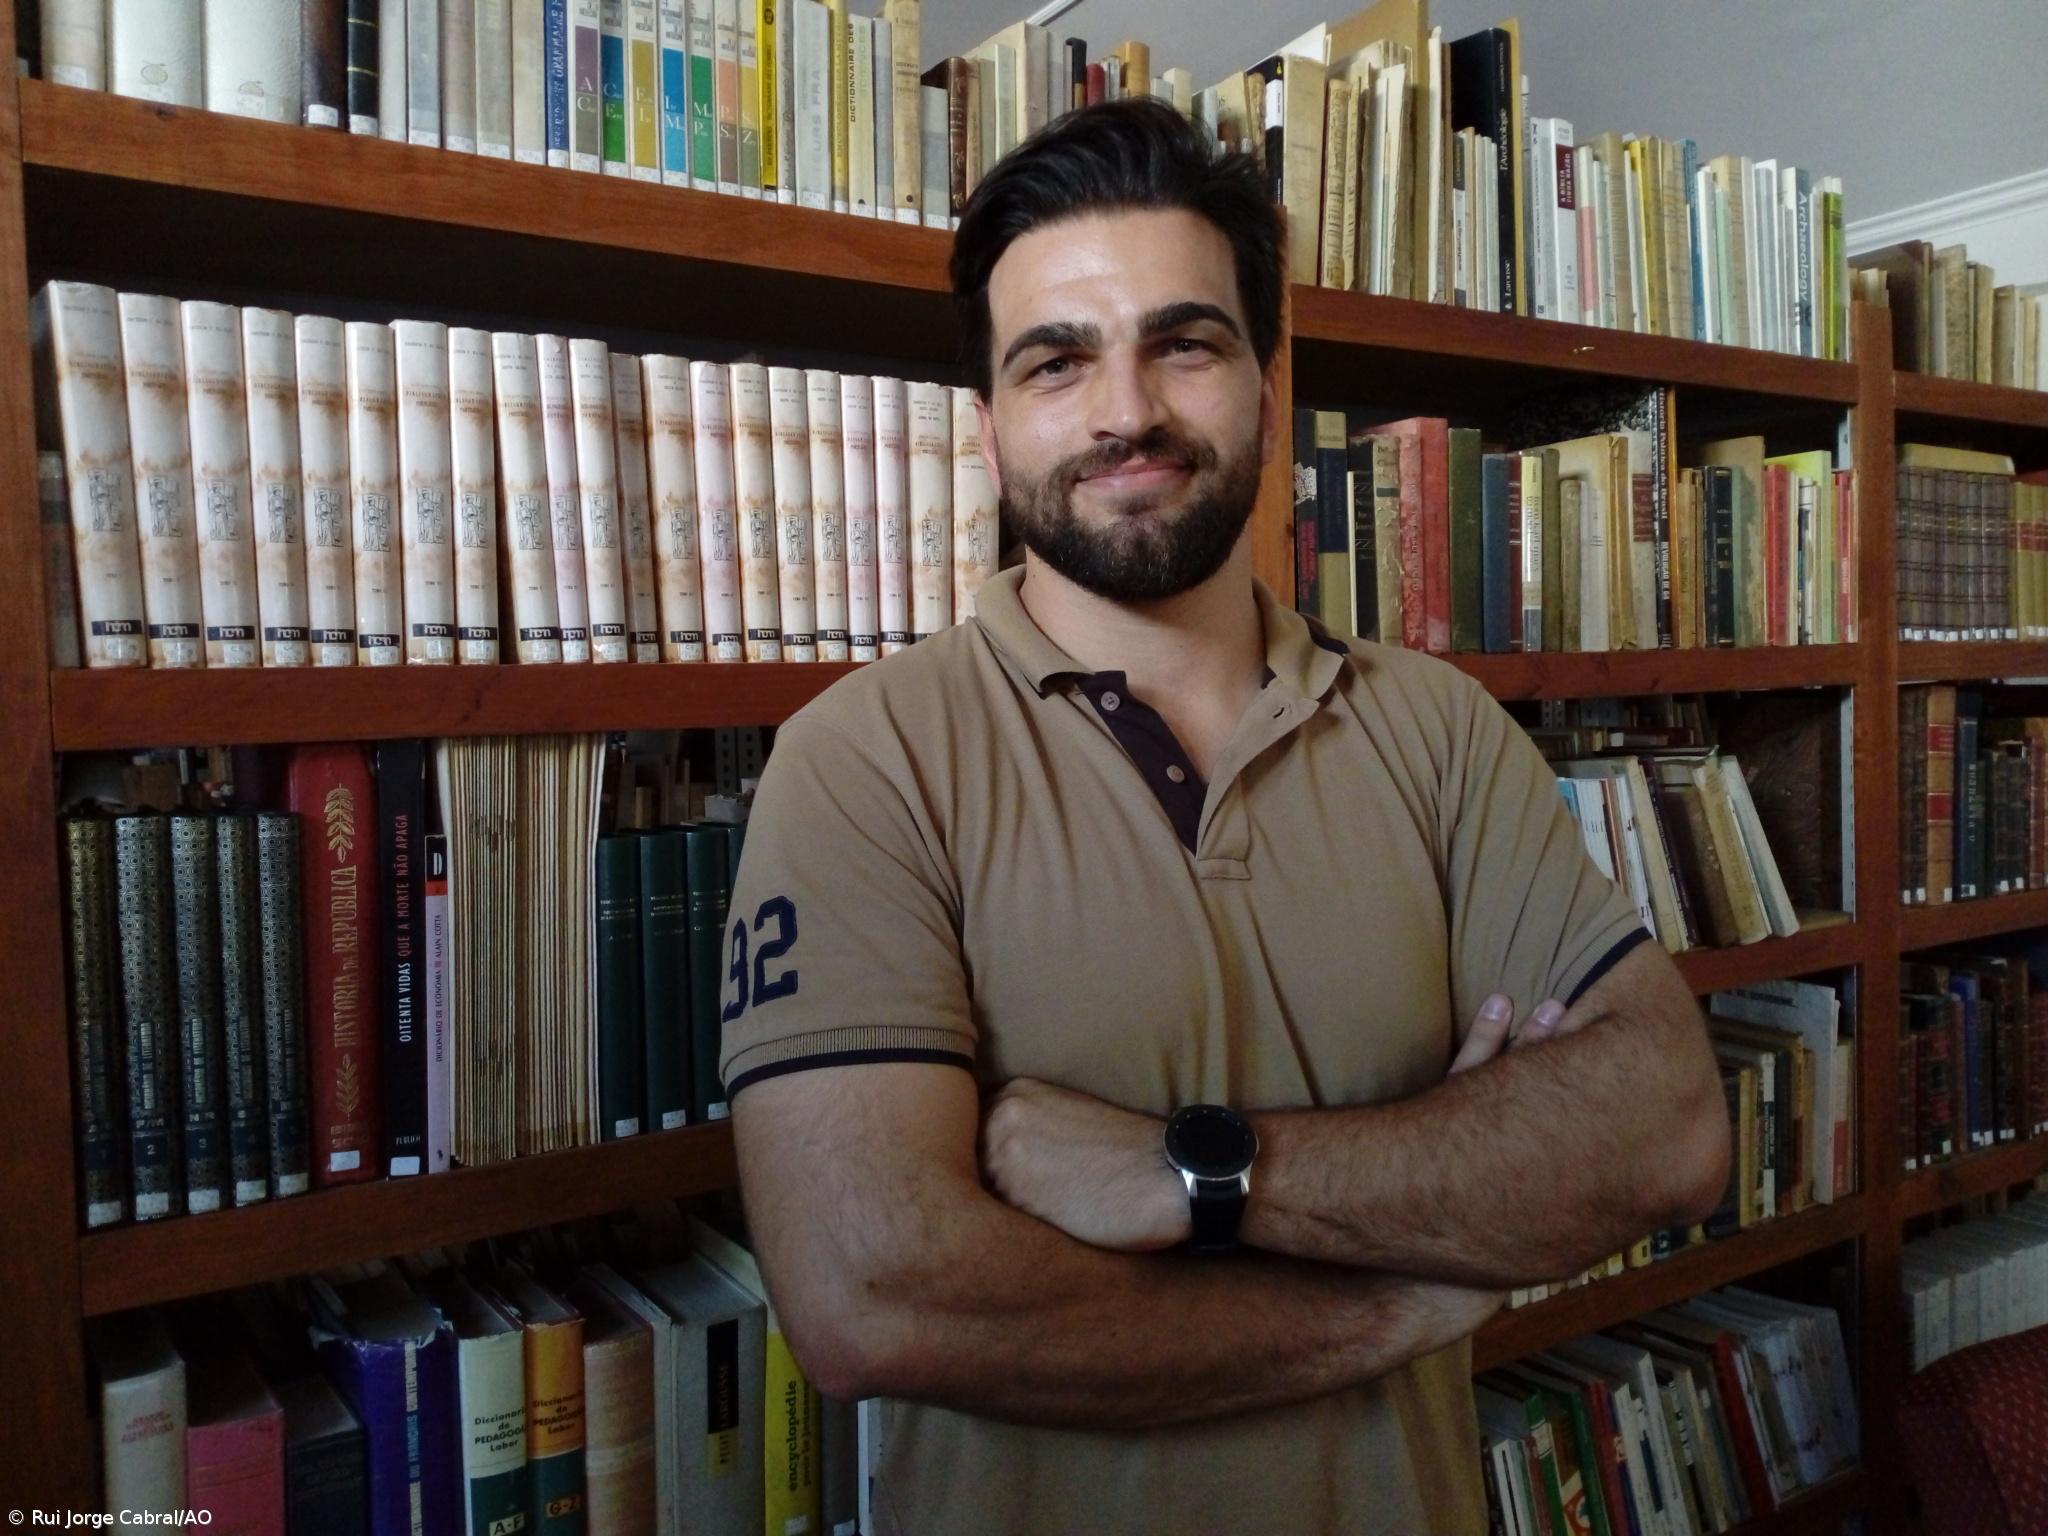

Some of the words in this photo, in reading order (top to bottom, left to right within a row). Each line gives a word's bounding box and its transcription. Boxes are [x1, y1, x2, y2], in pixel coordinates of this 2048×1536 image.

[849, 48, 857, 123] DICTIONNAIRE
[1798, 191, 1809, 302] Archaeology
[394, 814, 409, 849] APAGA
[393, 854, 409, 876] NÃO
[433, 852, 442, 876] D
[396, 882, 409, 917] MORTE
[397, 922, 409, 930] A
[433, 914, 441, 936] COTTA
[398, 936, 411, 957] QUE
[434, 938, 442, 958] ALAIN
[722, 895, 798, 1022] 92
[398, 962, 411, 993] VIDAS
[399, 997, 412, 1042] OITENTA
[474, 1407, 526, 1425] Diccionari
[475, 1426, 526, 1445] PEDAGOGI
[785, 1380, 799, 1492] encyclopédie
[494, 1514, 522, 1535] A-F
